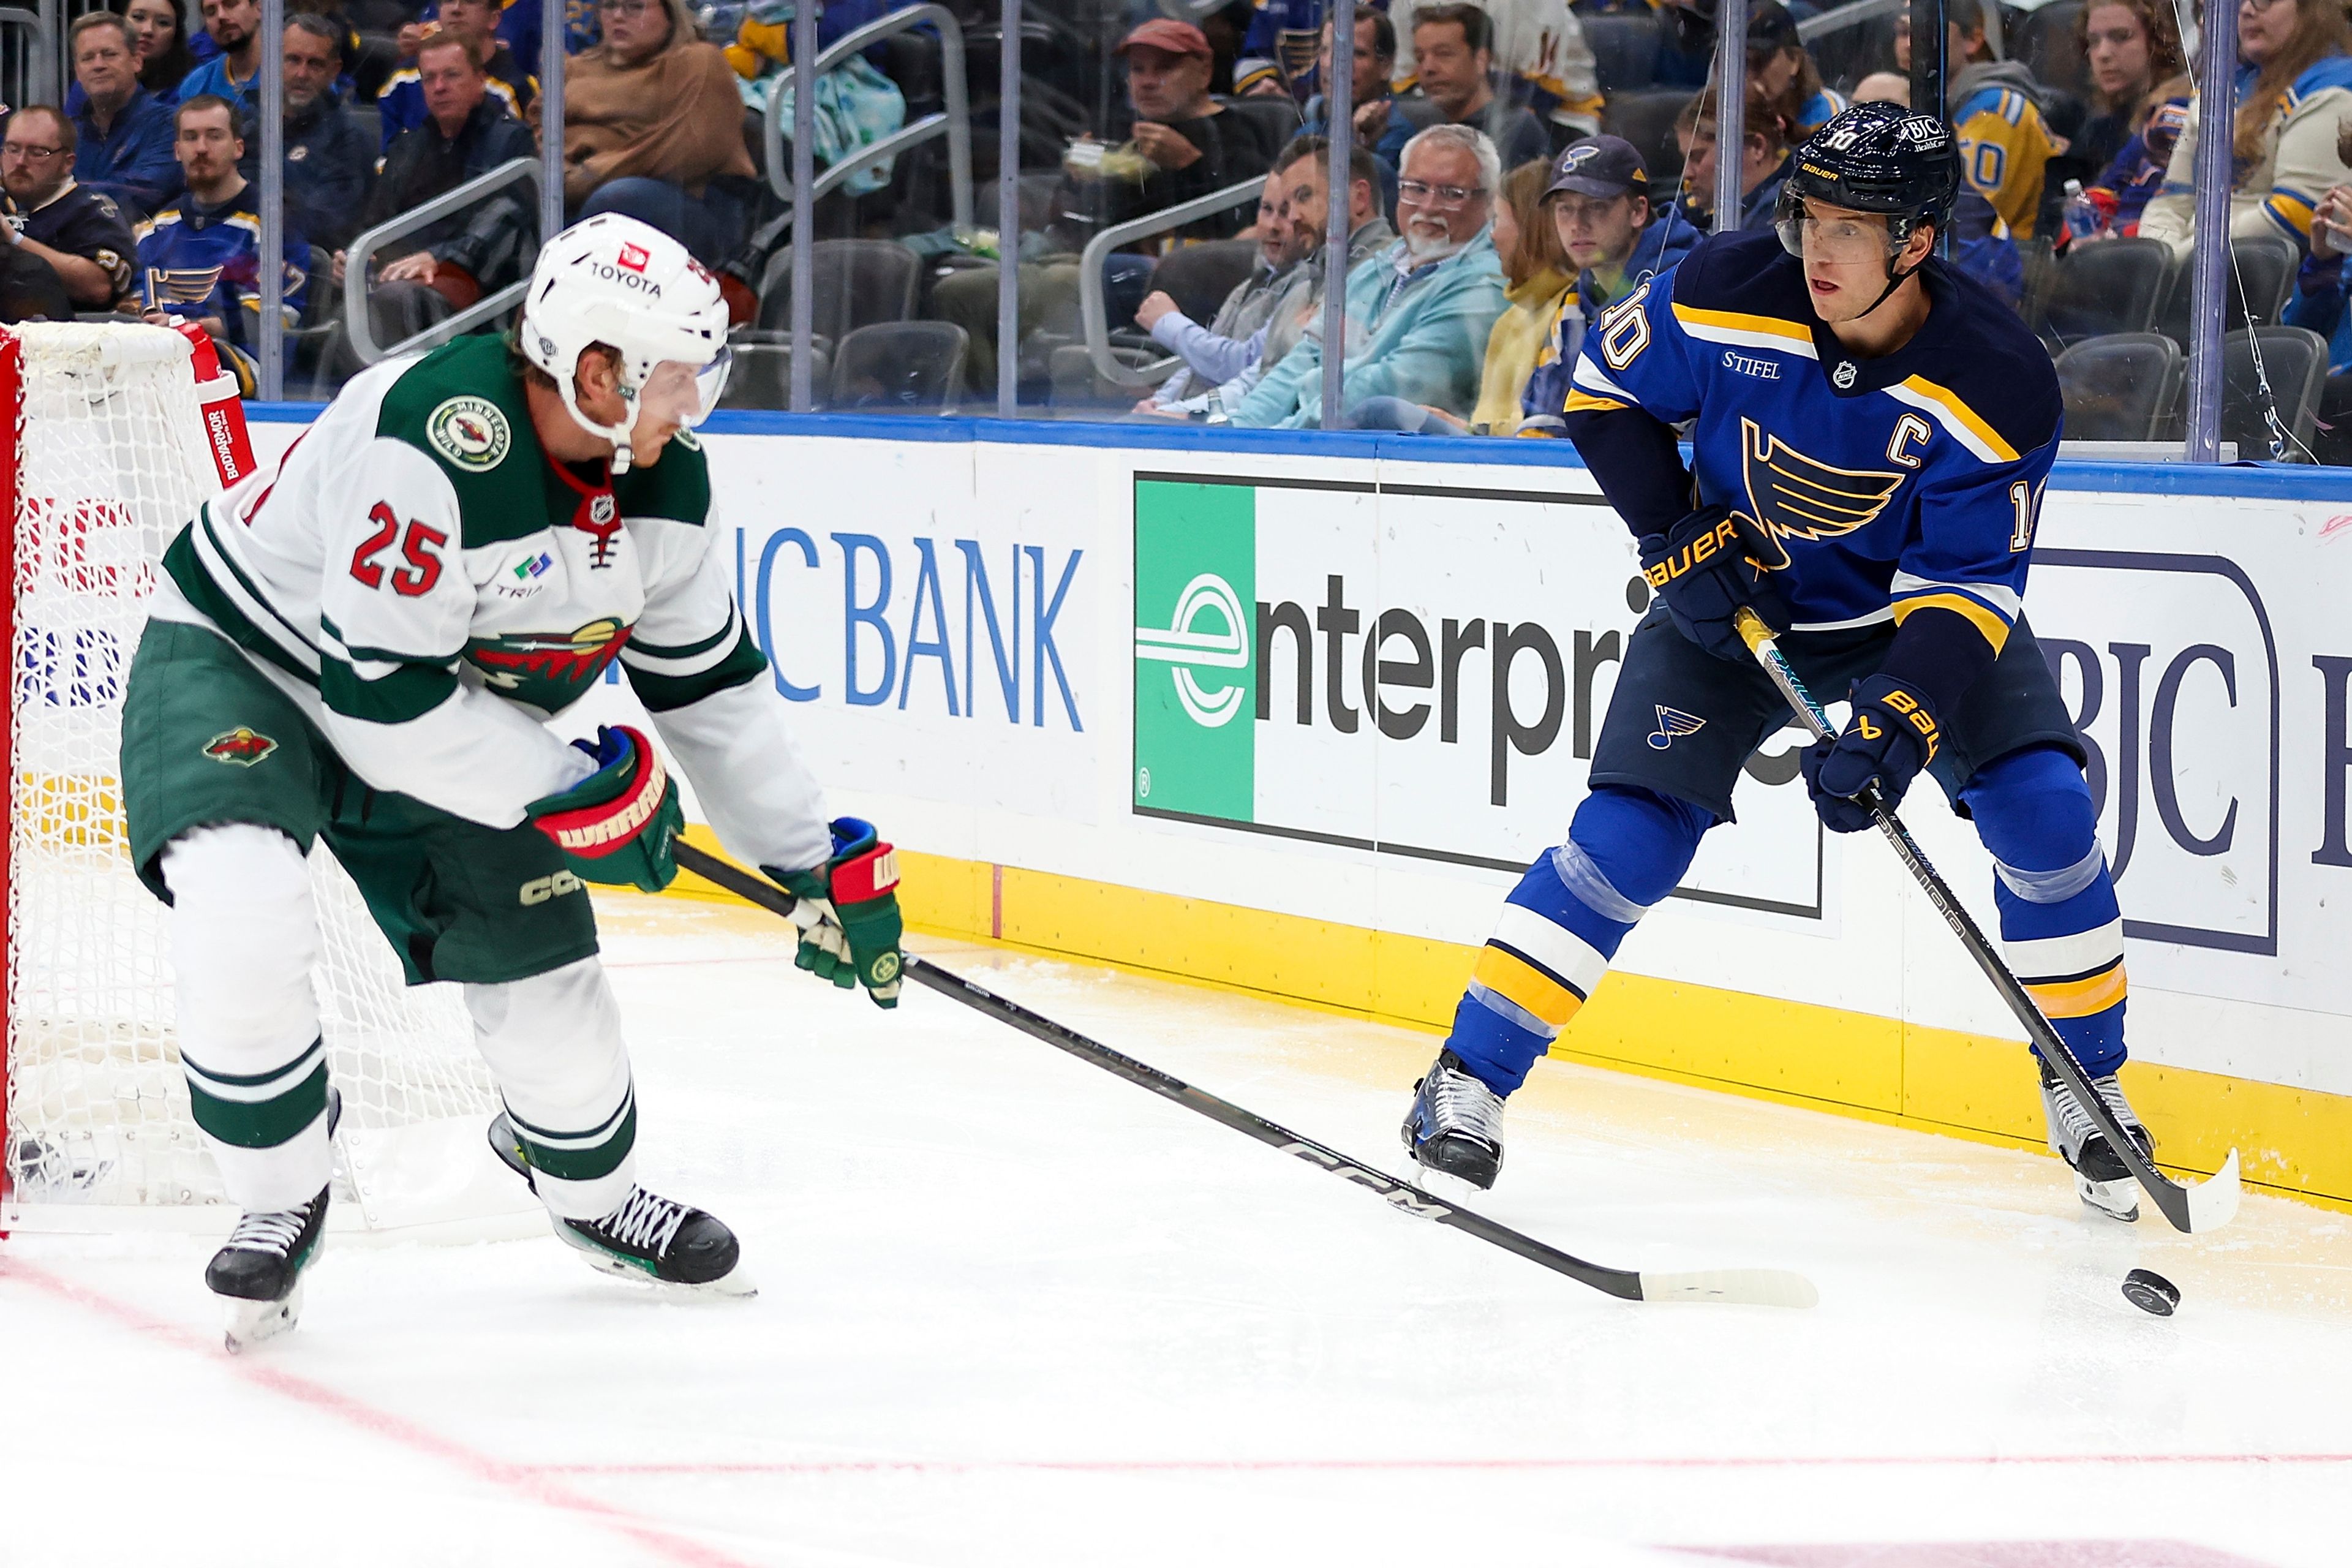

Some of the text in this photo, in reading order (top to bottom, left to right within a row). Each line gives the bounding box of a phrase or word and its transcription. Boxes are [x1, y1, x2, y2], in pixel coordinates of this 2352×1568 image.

[1906, 119, 1939, 138] BJC
[1801, 163, 1839, 181] BAUER
[592, 262, 662, 299] TOYOTA
[1600, 283, 1652, 371] 10
[1722, 351, 1781, 380] STIFEL
[208, 410, 239, 480] BODYARMOR
[1887, 412, 1932, 469] C
[350, 500, 447, 598] 25
[831, 532, 1084, 733] BANK
[1136, 573, 1814, 807] enterpr
[2036, 638, 2238, 886] BJC
[1280, 1142, 1452, 1219] CCM
